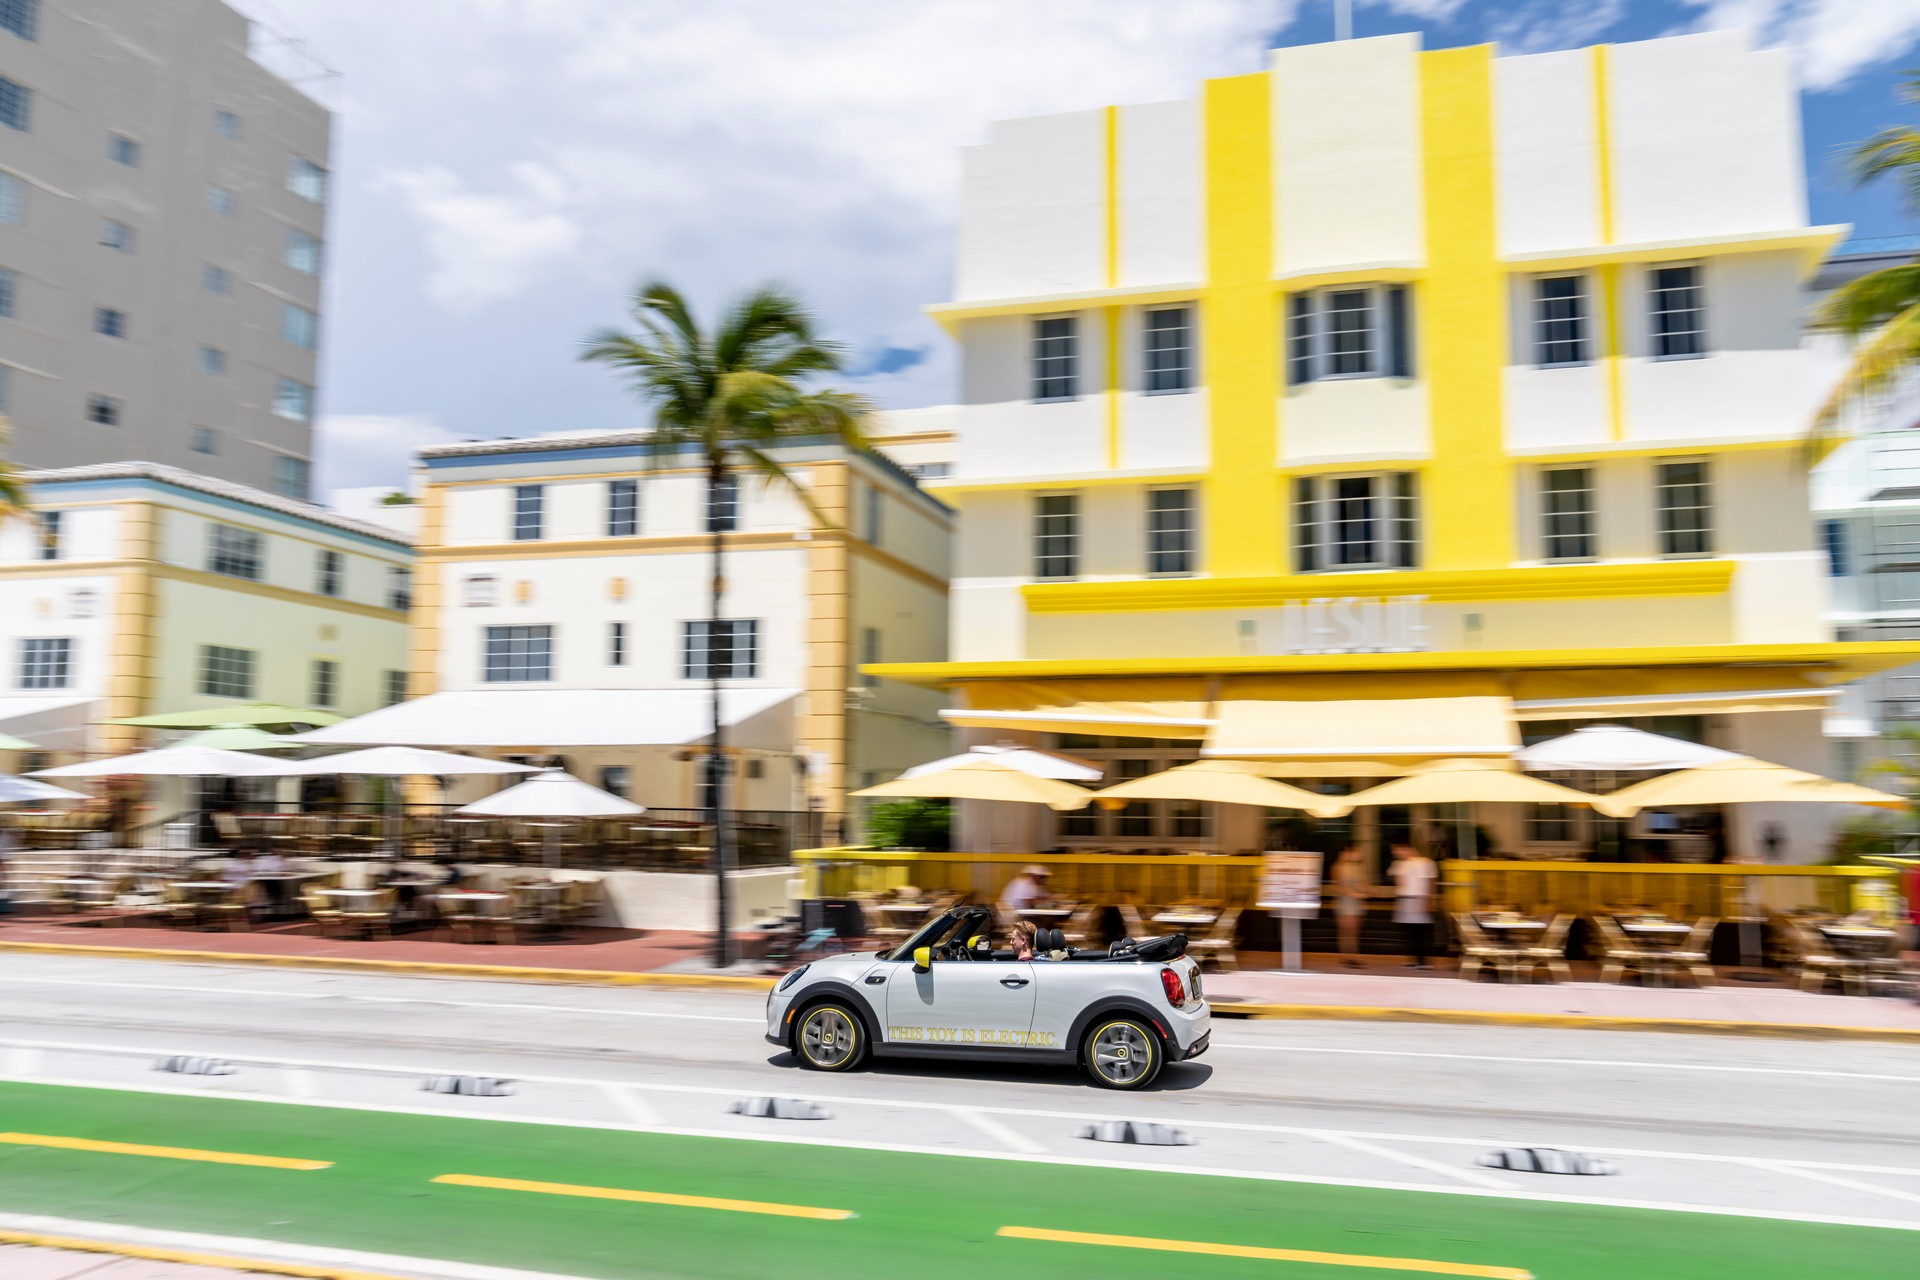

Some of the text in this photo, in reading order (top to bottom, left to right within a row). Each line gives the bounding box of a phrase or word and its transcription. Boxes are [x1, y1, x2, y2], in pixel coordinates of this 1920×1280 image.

[889, 1026, 1061, 1046] THIS TOY IS ELECTRIC.
